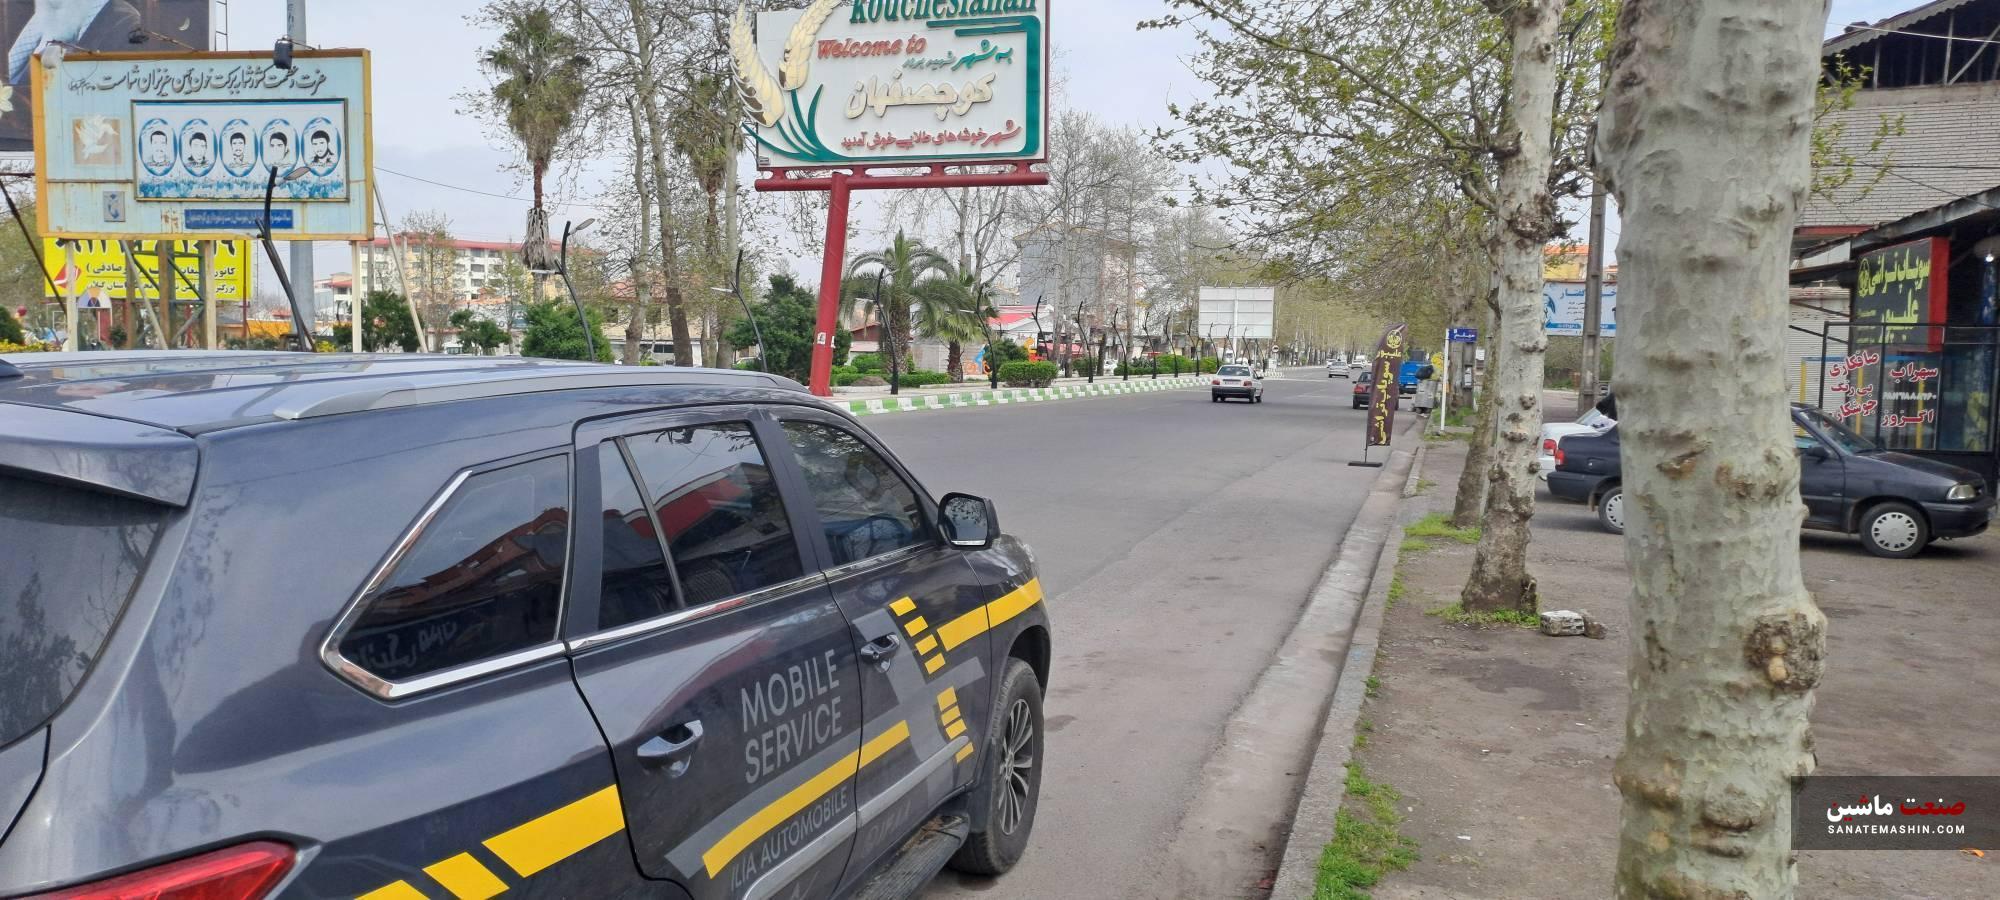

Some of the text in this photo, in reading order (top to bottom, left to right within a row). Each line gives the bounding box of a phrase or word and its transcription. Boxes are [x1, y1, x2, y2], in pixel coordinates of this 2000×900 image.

[818, 34, 928, 59] Welcome to
[951, 39, 998, 72] شهر
[841, 131, 868, 150] آمدید
[866, 132, 896, 150] خوش
[932, 130, 957, 145] های
[980, 119, 1022, 148] شهر
[1829, 350, 1879, 377] صافکاری
[1888, 362, 1939, 383] سهراب
[1856, 383, 1874, 398] بی
[740, 648, 840, 733] MOBILE
[744, 695, 843, 785] SERVICE
[730, 858, 758, 892] ILIA
[759, 785, 849, 865] AUTOMOBILE
